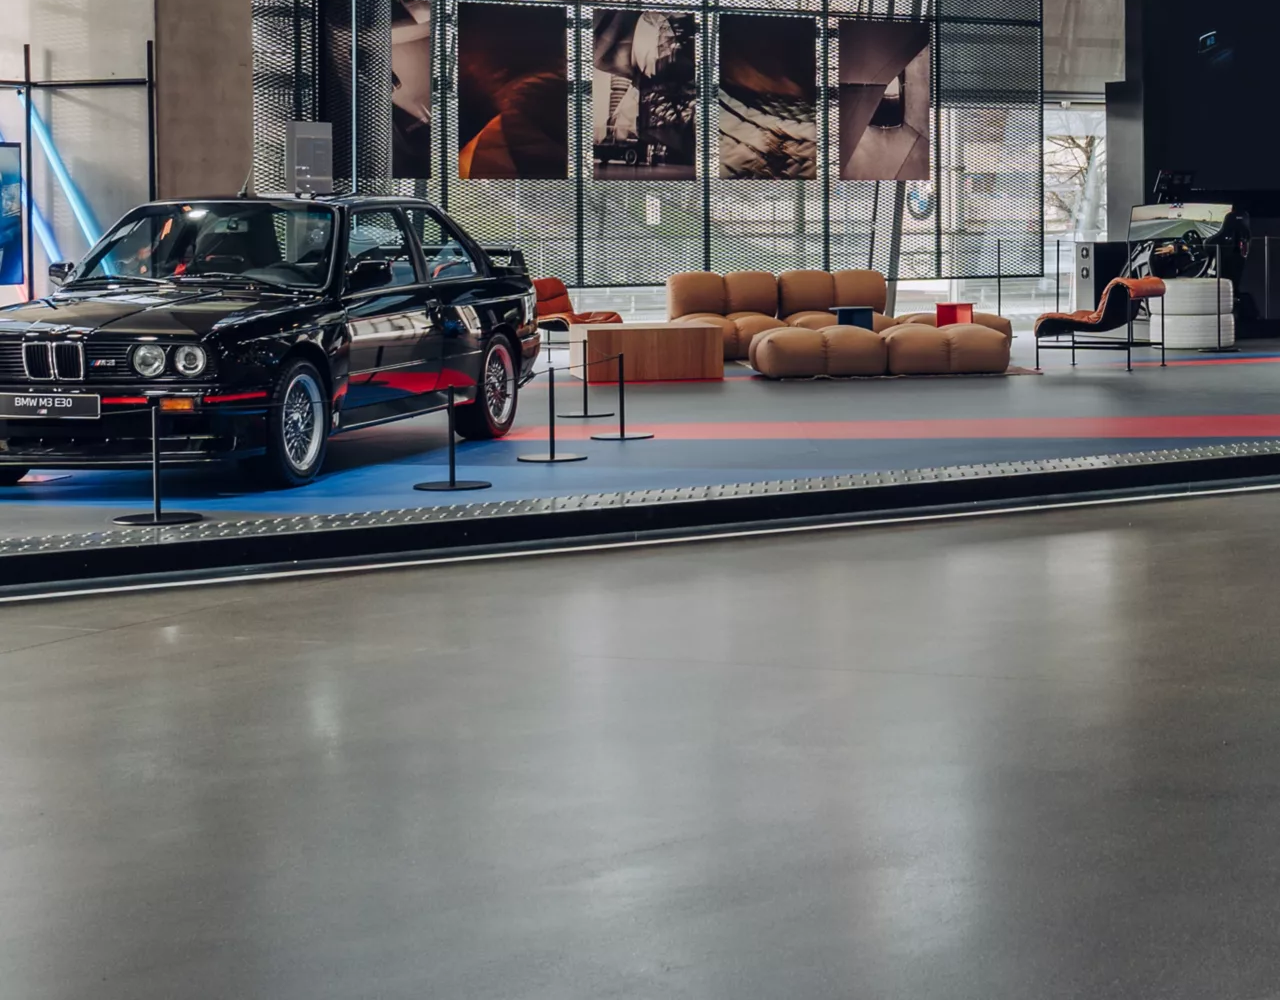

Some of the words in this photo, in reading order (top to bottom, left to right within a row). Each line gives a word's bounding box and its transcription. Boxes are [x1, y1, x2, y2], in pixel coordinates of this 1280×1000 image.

[14, 396, 38, 407] BMW
[39, 397, 53, 407] M3
[54, 397, 73, 408] E30
